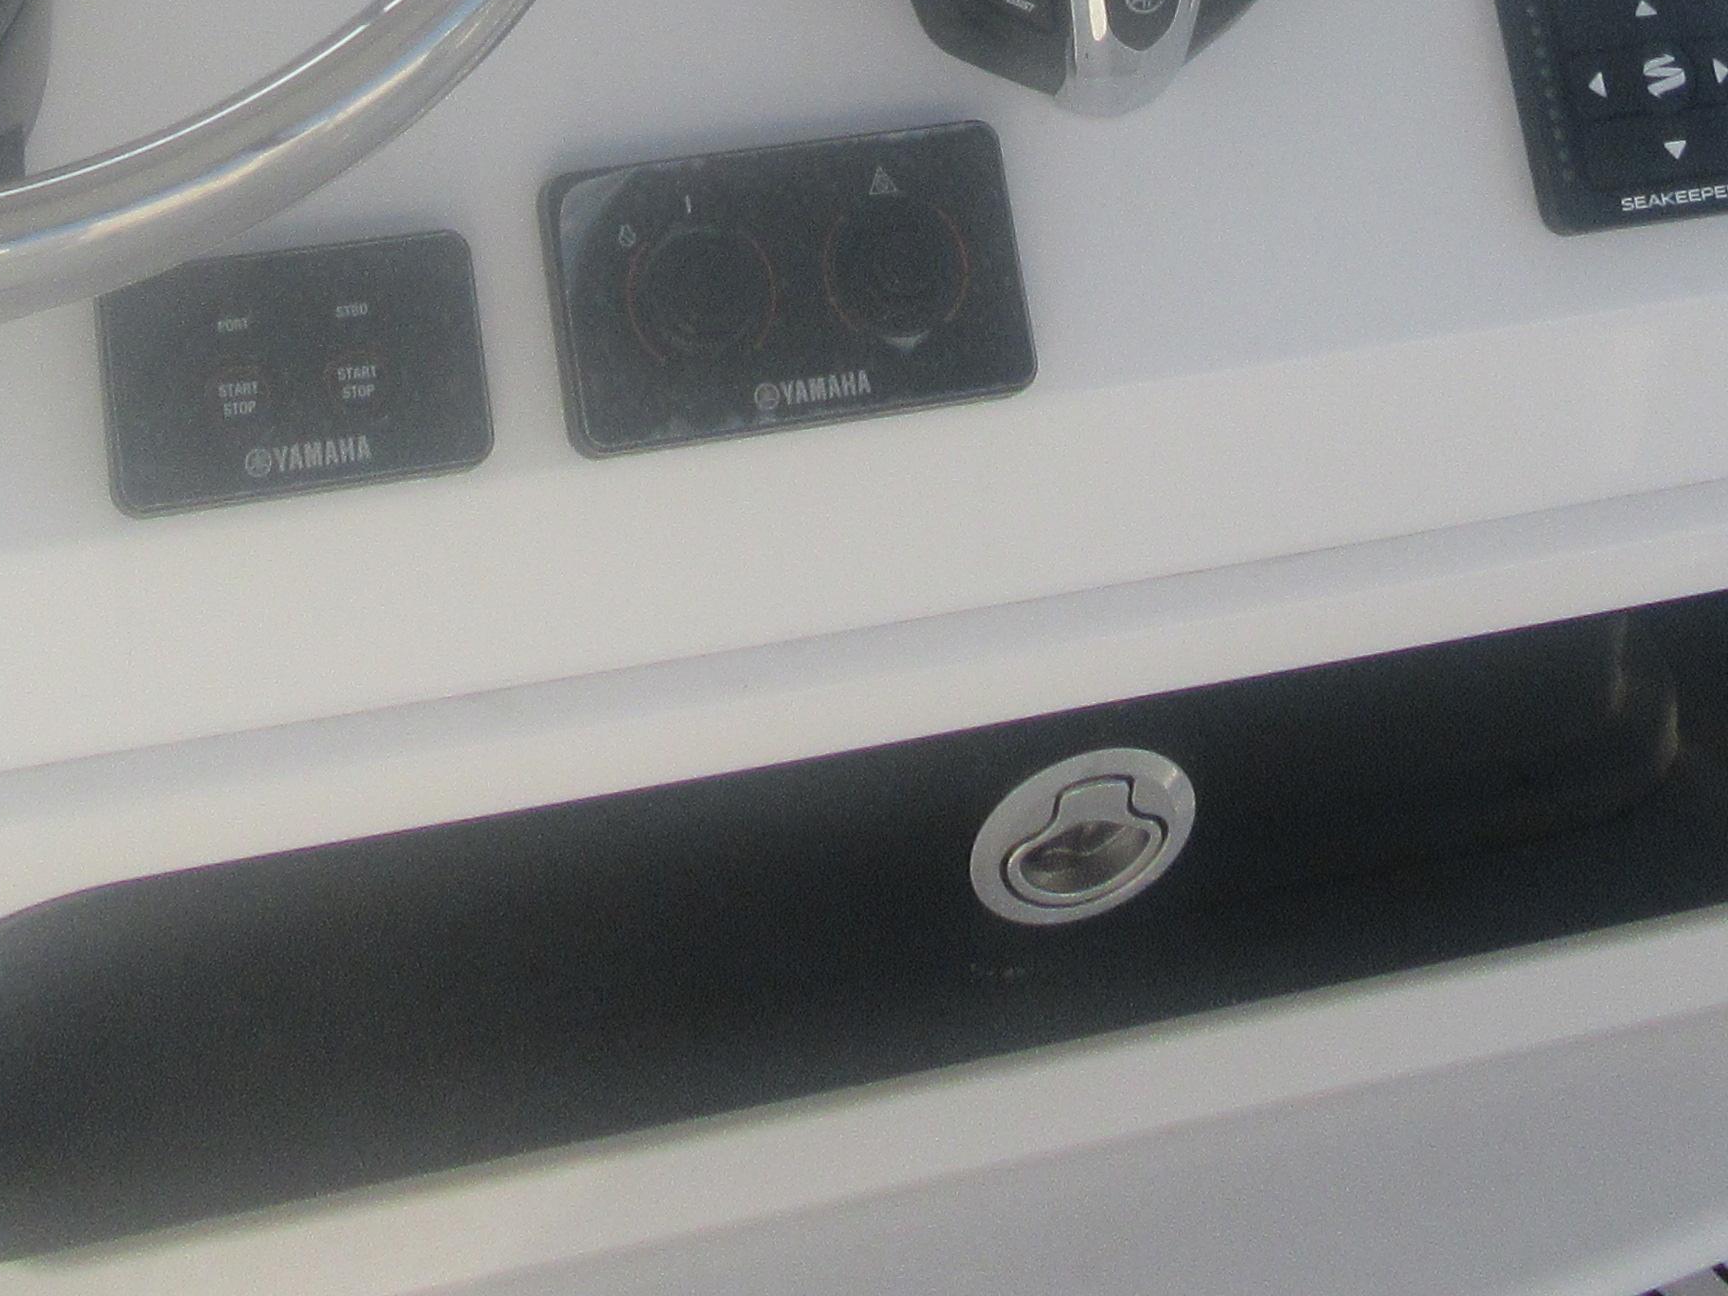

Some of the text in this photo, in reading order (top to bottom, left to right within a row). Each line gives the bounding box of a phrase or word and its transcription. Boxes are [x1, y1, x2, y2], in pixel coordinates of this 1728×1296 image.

[337, 365, 378, 382] START
[218, 380, 259, 398] START
[342, 383, 376, 400] STOP
[779, 368, 872, 406] YAMAHA
[223, 400, 257, 417] STOP
[272, 434, 373, 473] YAMAHA
